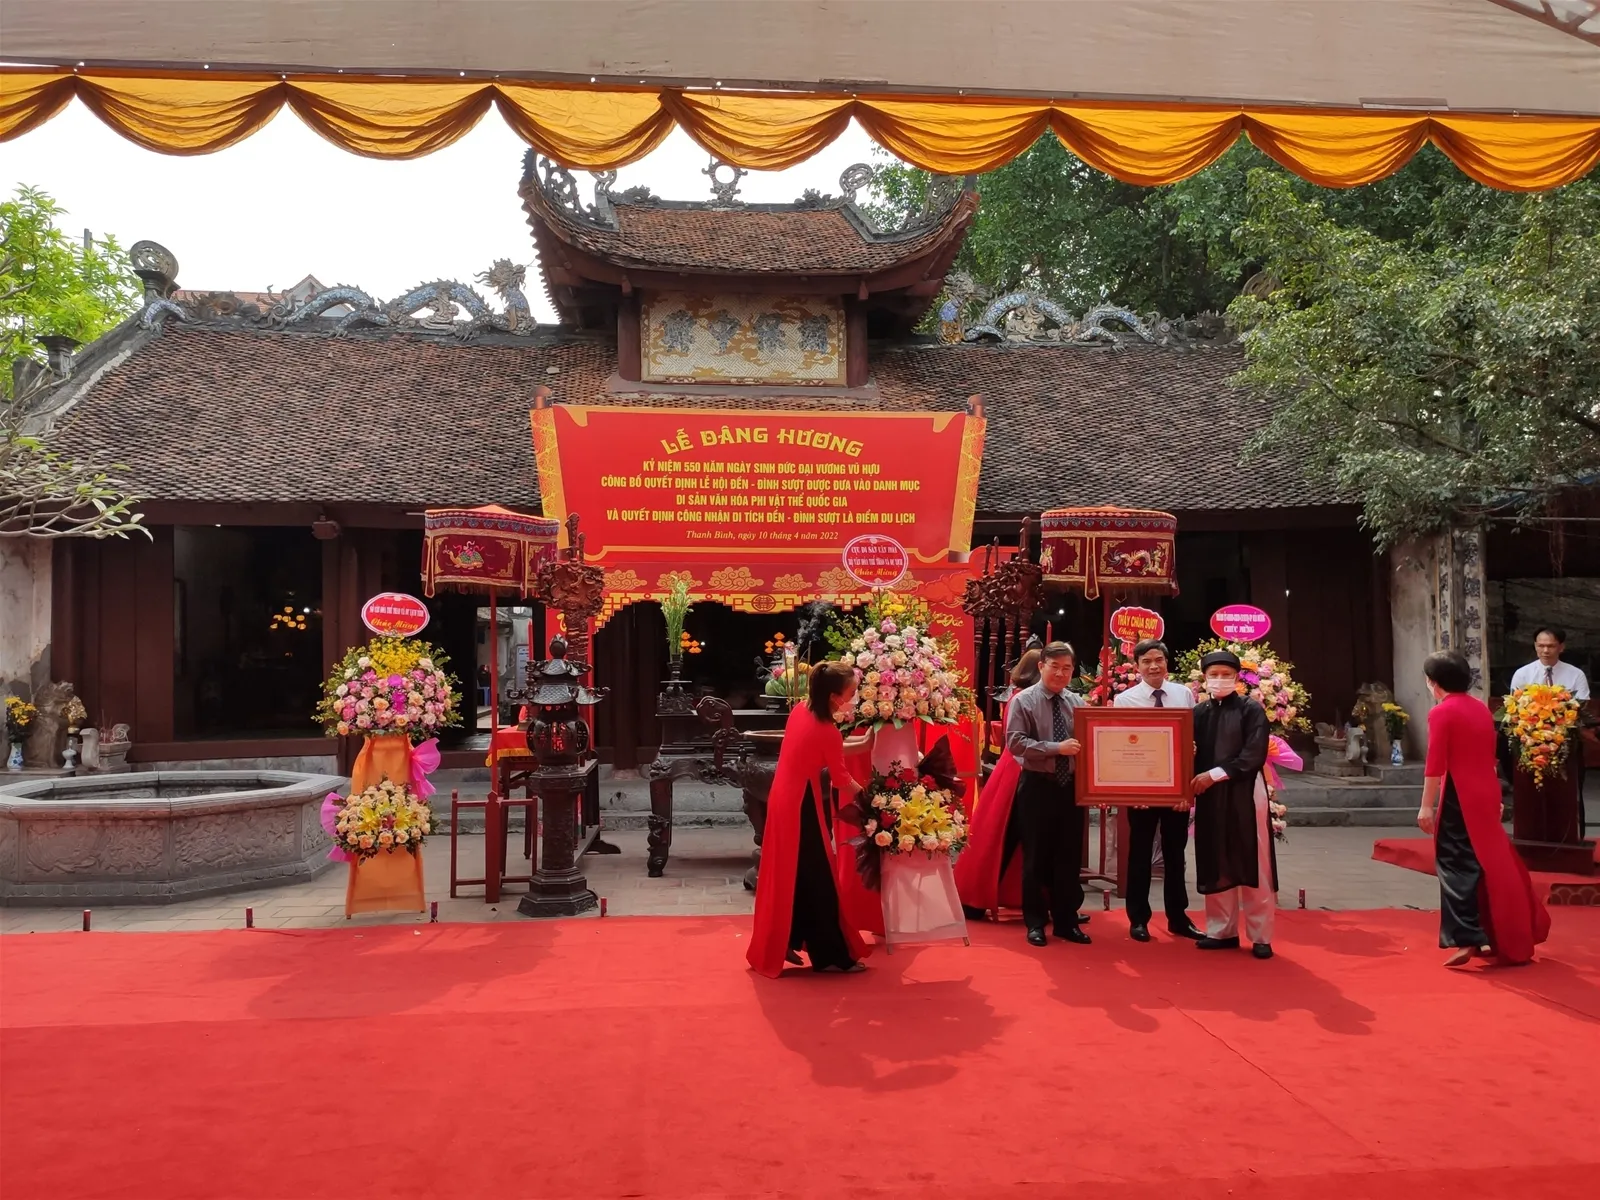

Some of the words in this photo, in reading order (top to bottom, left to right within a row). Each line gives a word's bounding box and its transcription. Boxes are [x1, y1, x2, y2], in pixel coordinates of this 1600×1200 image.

[661, 428, 694, 454] LỄ
[777, 428, 864, 457] HƯƠNG
[643, 458, 655, 471] KỶ
[658, 460, 681, 474] NIỆM
[684, 462, 700, 472] 550
[704, 461, 724, 472] NĂM
[727, 462, 751, 473] NGÀY
[754, 463, 775, 473] SINH
[778, 462, 796, 474] ĐỨC
[798, 464, 813, 476] ĐẠI
[816, 463, 846, 474] VƯƠNG
[601, 475, 626, 487] CÔNG
[629, 474, 642, 487] BỐ
[644, 475, 672, 489] QUYẾT
[675, 478, 697, 491] ĐỊNH
[700, 475, 710, 489] LỄ
[713, 478, 727, 491] HỘI
[757, 478, 779, 490] ĐÌNH
[782, 479, 804, 492] SƯỢT
[807, 480, 830, 492] ĐƯỢC
[833, 480, 851, 491] ĐƯA
[854, 478, 871, 491] VÀO
[874, 480, 897, 491] DANH
[900, 481, 920, 493] MỤC
[676, 494, 685, 505] DI
[688, 491, 707, 505] SẢN
[709, 494, 727, 506] VĂN
[730, 494, 748, 506] HÓA
[751, 496, 766, 506] PHI
[769, 494, 785, 508] VẬT
[788, 492, 803, 506] THỂ
[806, 494, 830, 507] QUỐC
[833, 497, 848, 507] GIA
[607, 508, 619, 520] VÀ
[622, 507, 649, 521] QUYẾT
[652, 511, 675, 523] ĐỊNH
[677, 509, 702, 522] CÔNG
[704, 511, 730, 524] NHẬN
[732, 512, 742, 522] DI
[744, 510, 764, 522] TÍCH
[793, 511, 815, 523] ĐÌNH
[818, 512, 840, 525] SƯỢT
[843, 511, 853, 523] LÀ
[856, 509, 878, 523] ĐIỂM
[881, 513, 893, 523] DU
[895, 513, 915, 525] LỊCH
[686, 530, 712, 539] Thanh
[738, 531, 756, 540] ngày
[769, 532, 792, 540] tháng
